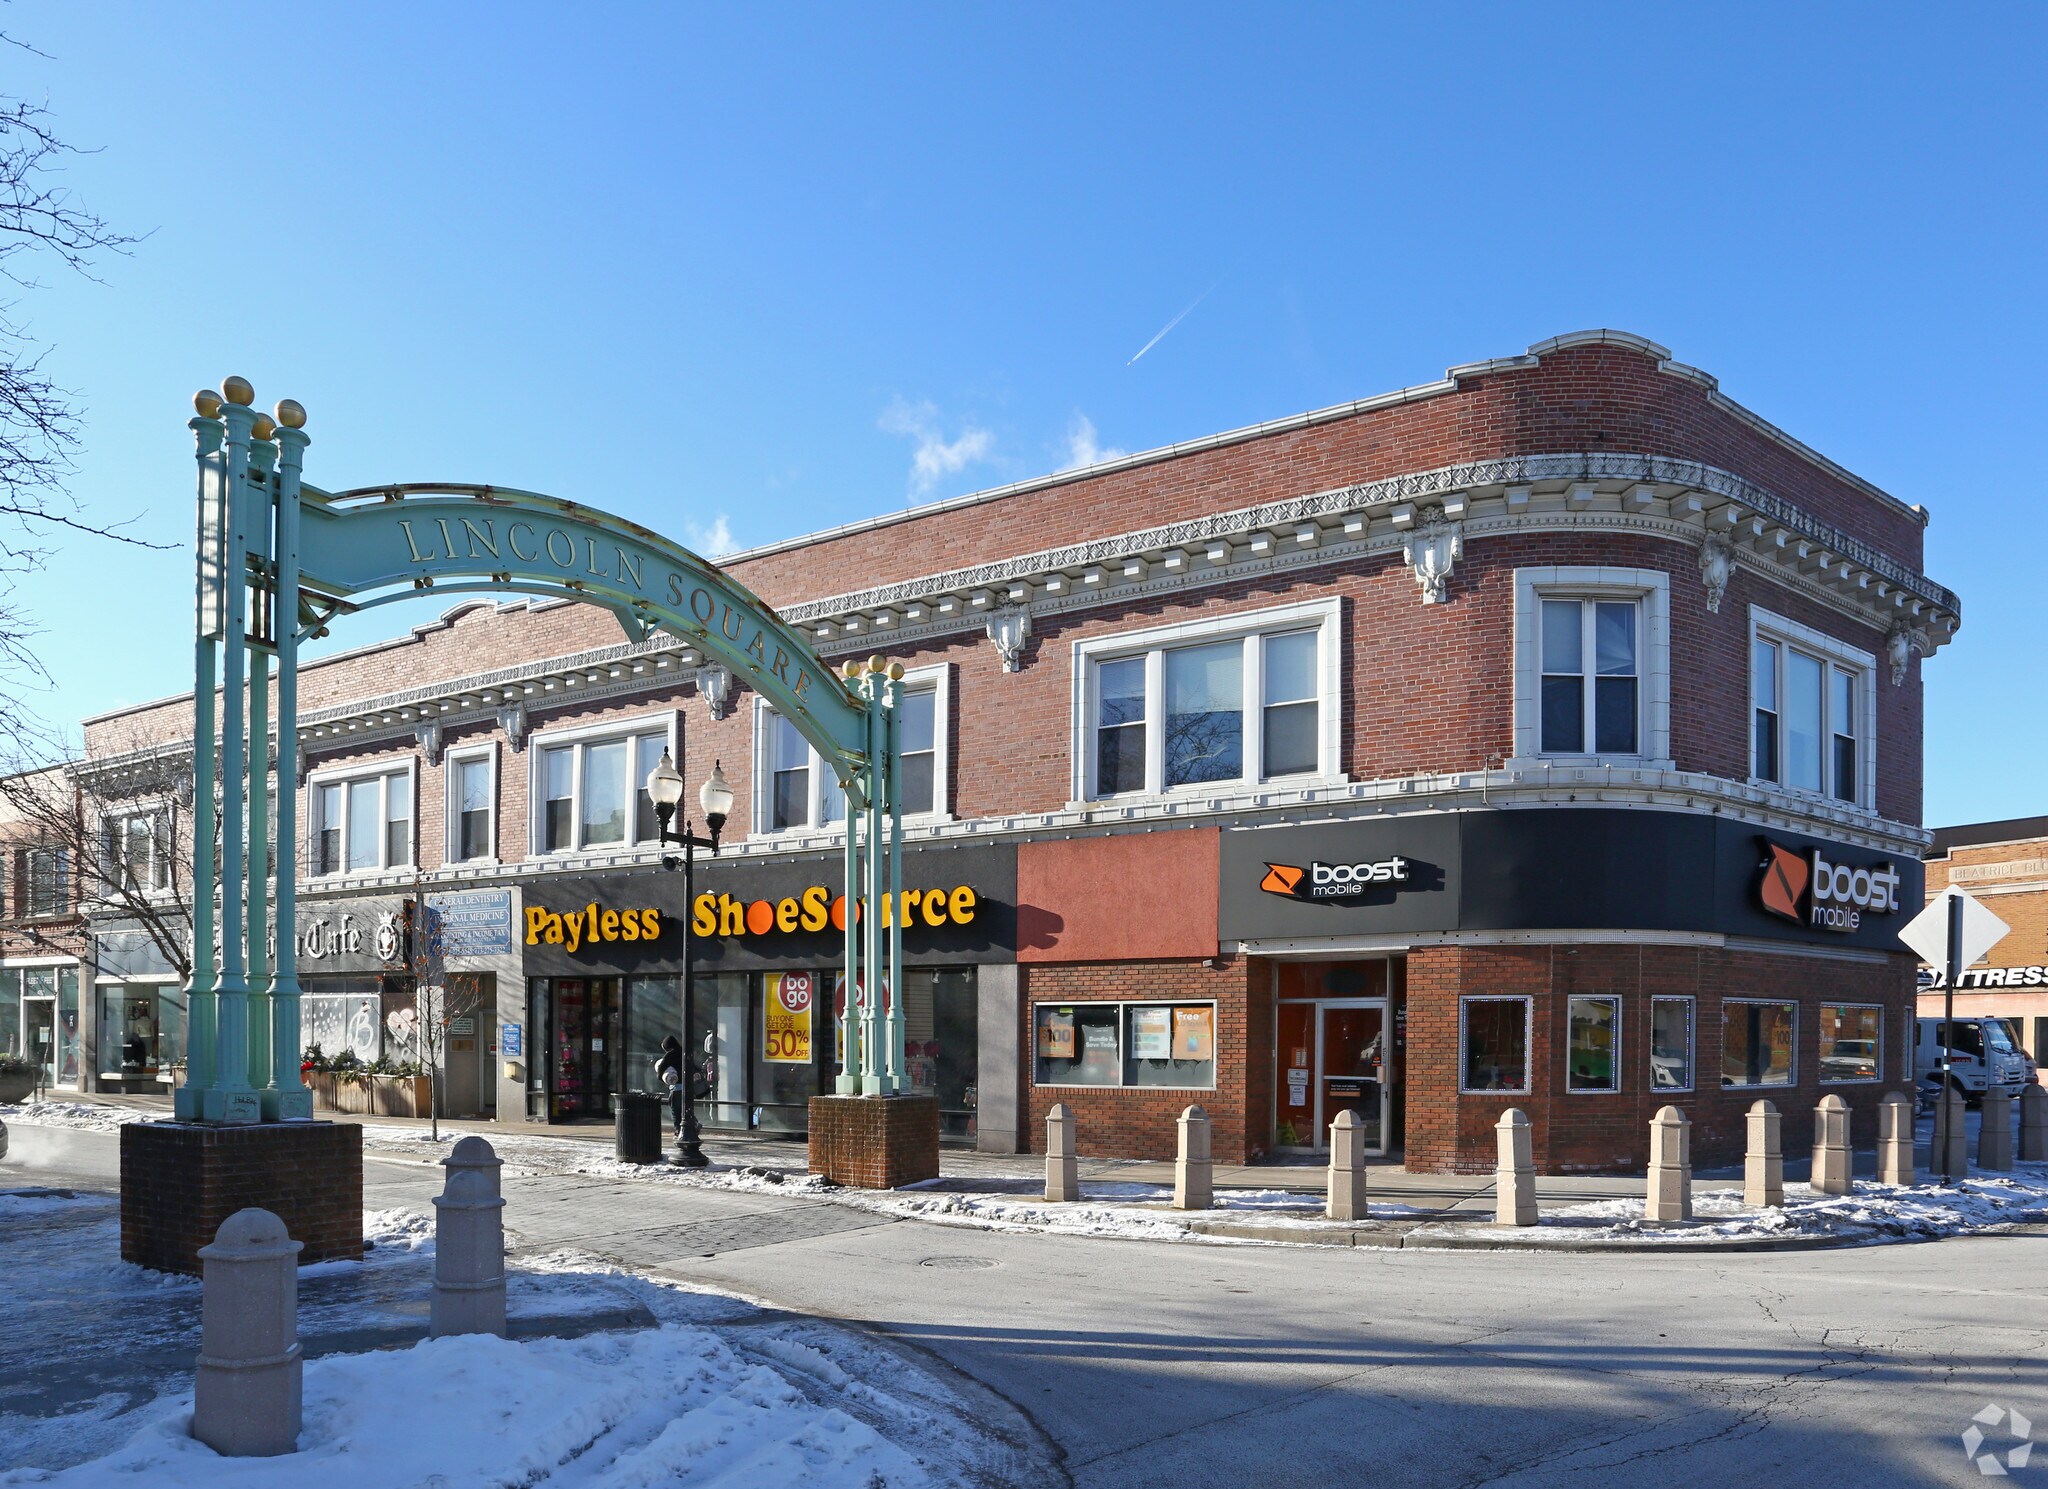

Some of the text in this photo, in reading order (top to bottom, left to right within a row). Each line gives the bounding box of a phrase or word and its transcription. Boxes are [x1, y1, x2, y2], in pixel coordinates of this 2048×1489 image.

[398, 518, 812, 704] LINCOLN SQUARE
[1313, 857, 1405, 884] boost
[1955, 864, 2017, 880] BEATRICE
[1814, 850, 1900, 911] boost
[1313, 883, 1363, 896] mobile
[466, 893, 504, 905] DENTISTRY
[469, 911, 505, 922] MEDICINE
[1812, 905, 1860, 929] mobile
[525, 902, 660, 953] Payless
[305, 914, 362, 960] Cafe
[786, 975, 808, 990] bo
[1917, 967, 2048, 989] ATTRES
[787, 990, 808, 1007] go
[1176, 1011, 1200, 1021] Free
[795, 1049, 809, 1057] OFF
